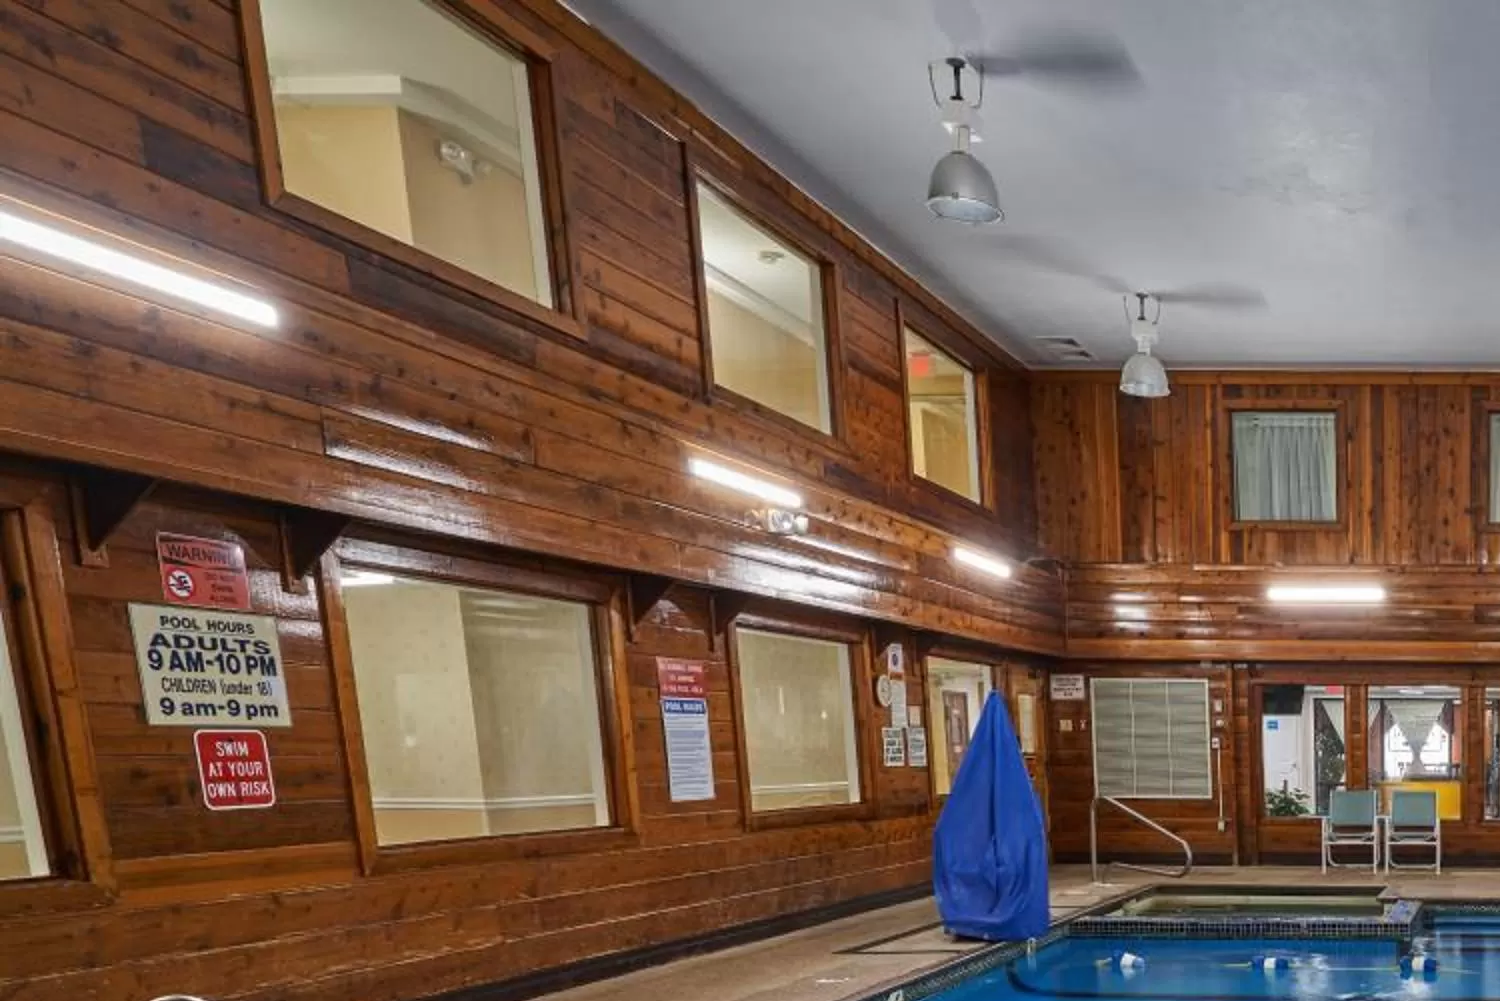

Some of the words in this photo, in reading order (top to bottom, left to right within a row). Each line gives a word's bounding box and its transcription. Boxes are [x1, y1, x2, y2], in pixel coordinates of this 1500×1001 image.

[160, 615, 201, 631] POOL
[206, 619, 255, 635] HOURS
[149, 632, 272, 655] ADULTS
[147, 649, 163, 671] 9
[169, 650, 241, 675] AM-10
[246, 656, 278, 677] PM
[161, 676, 217, 694] CHILDREN
[219, 679, 253, 696] (under
[160, 697, 175, 716] 9
[181, 699, 241, 717] am-9
[246, 704, 279, 720] pm
[215, 741, 249, 757] SWIM
[209, 762, 223, 777] AT
[227, 761, 264, 777] YOUR
[207, 782, 237, 799] OWN
[240, 781, 271, 797] RISK
